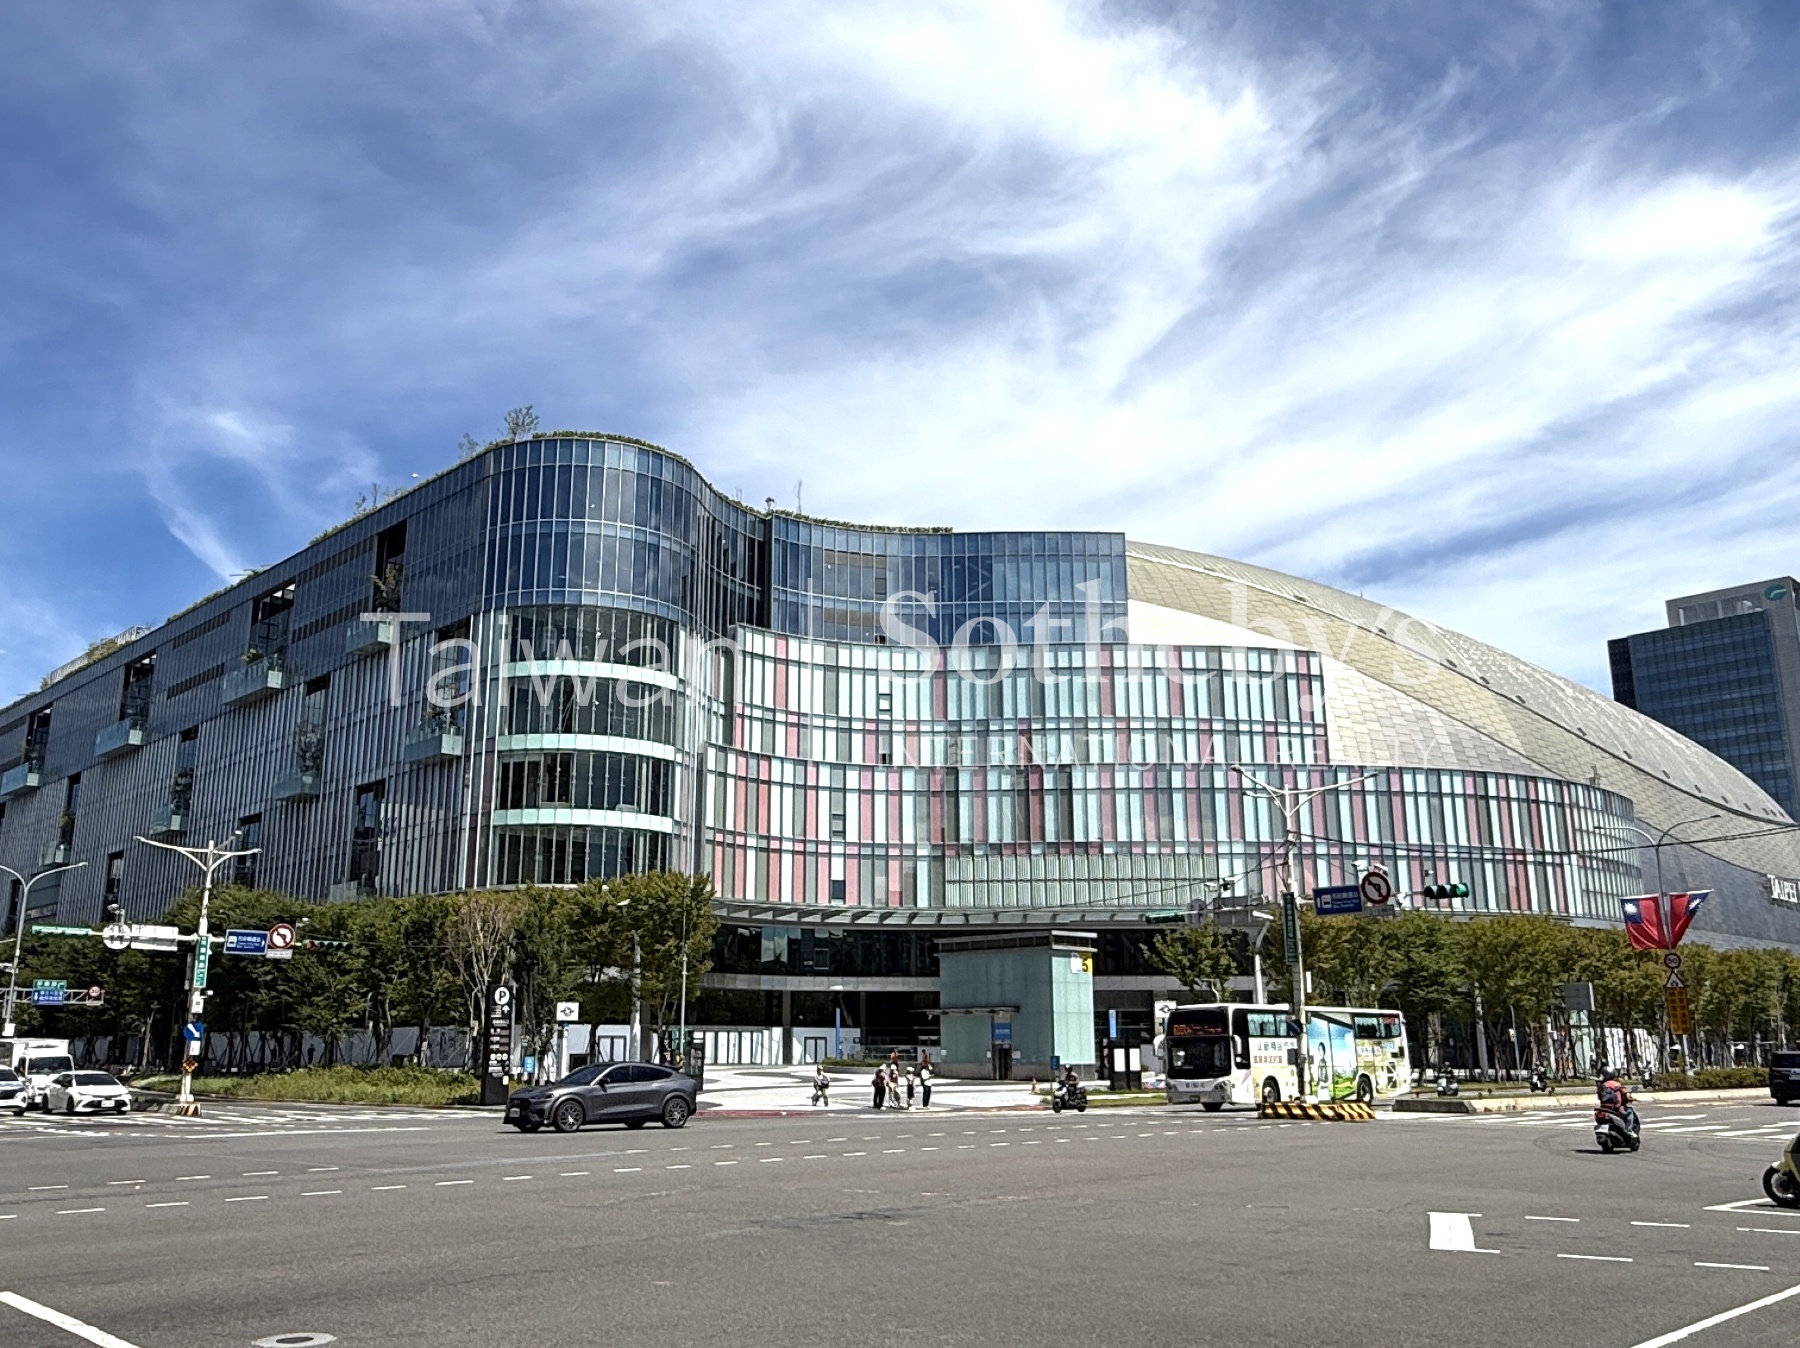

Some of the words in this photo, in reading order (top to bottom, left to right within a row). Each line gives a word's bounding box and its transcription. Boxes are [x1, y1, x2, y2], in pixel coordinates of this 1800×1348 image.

[1766, 873, 1798, 903] TAIPEI
[1081, 955, 1089, 972] 5
[498, 990, 506, 1002] P
